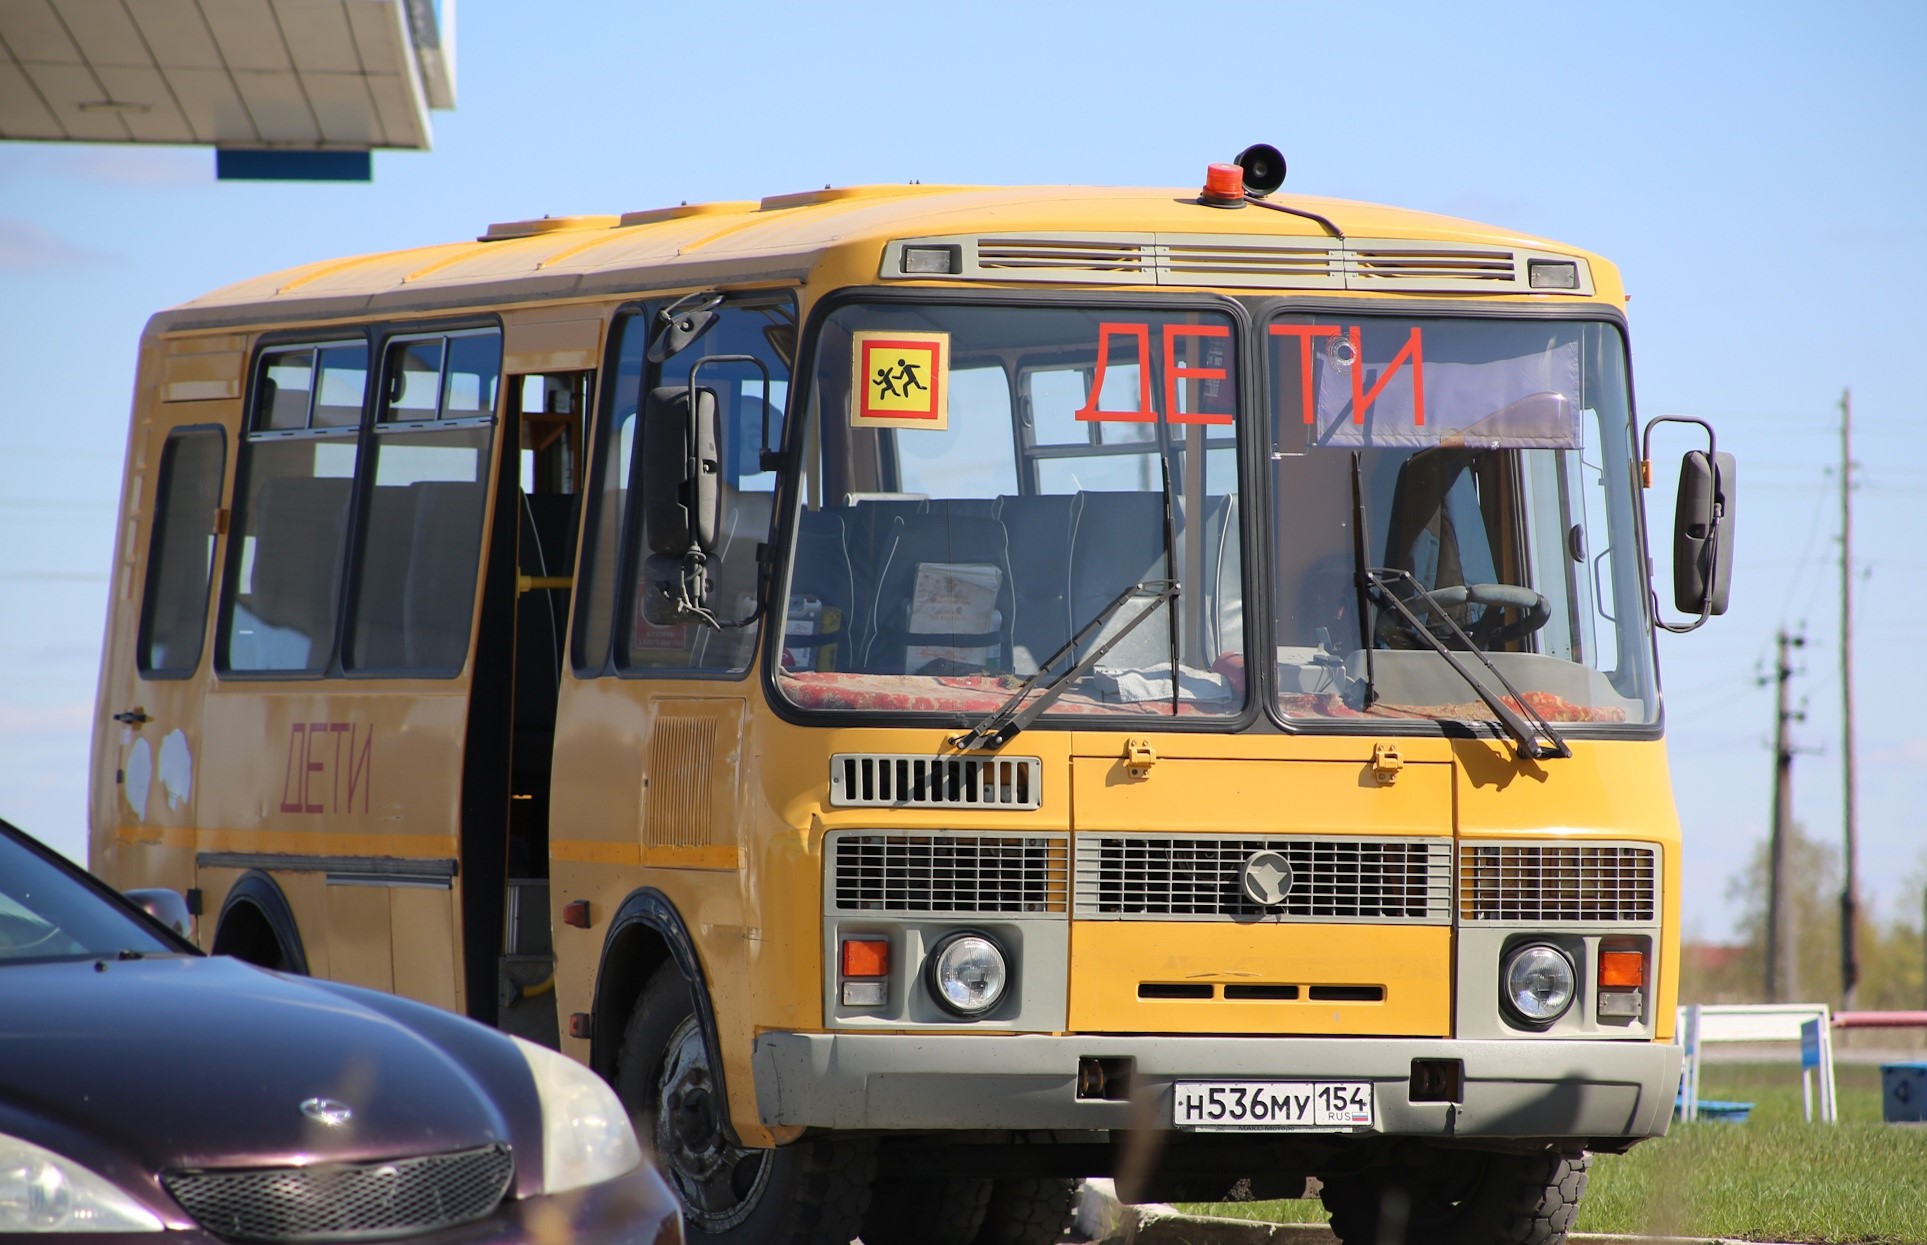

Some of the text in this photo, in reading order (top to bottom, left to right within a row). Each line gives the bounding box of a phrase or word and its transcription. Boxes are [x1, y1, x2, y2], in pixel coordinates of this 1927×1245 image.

[1075, 323, 1425, 427] ДЕТИ
[280, 723, 373, 814] ДЕТИ
[1318, 1087, 1364, 1112] 154
[1328, 1111, 1351, 1121] RUS
